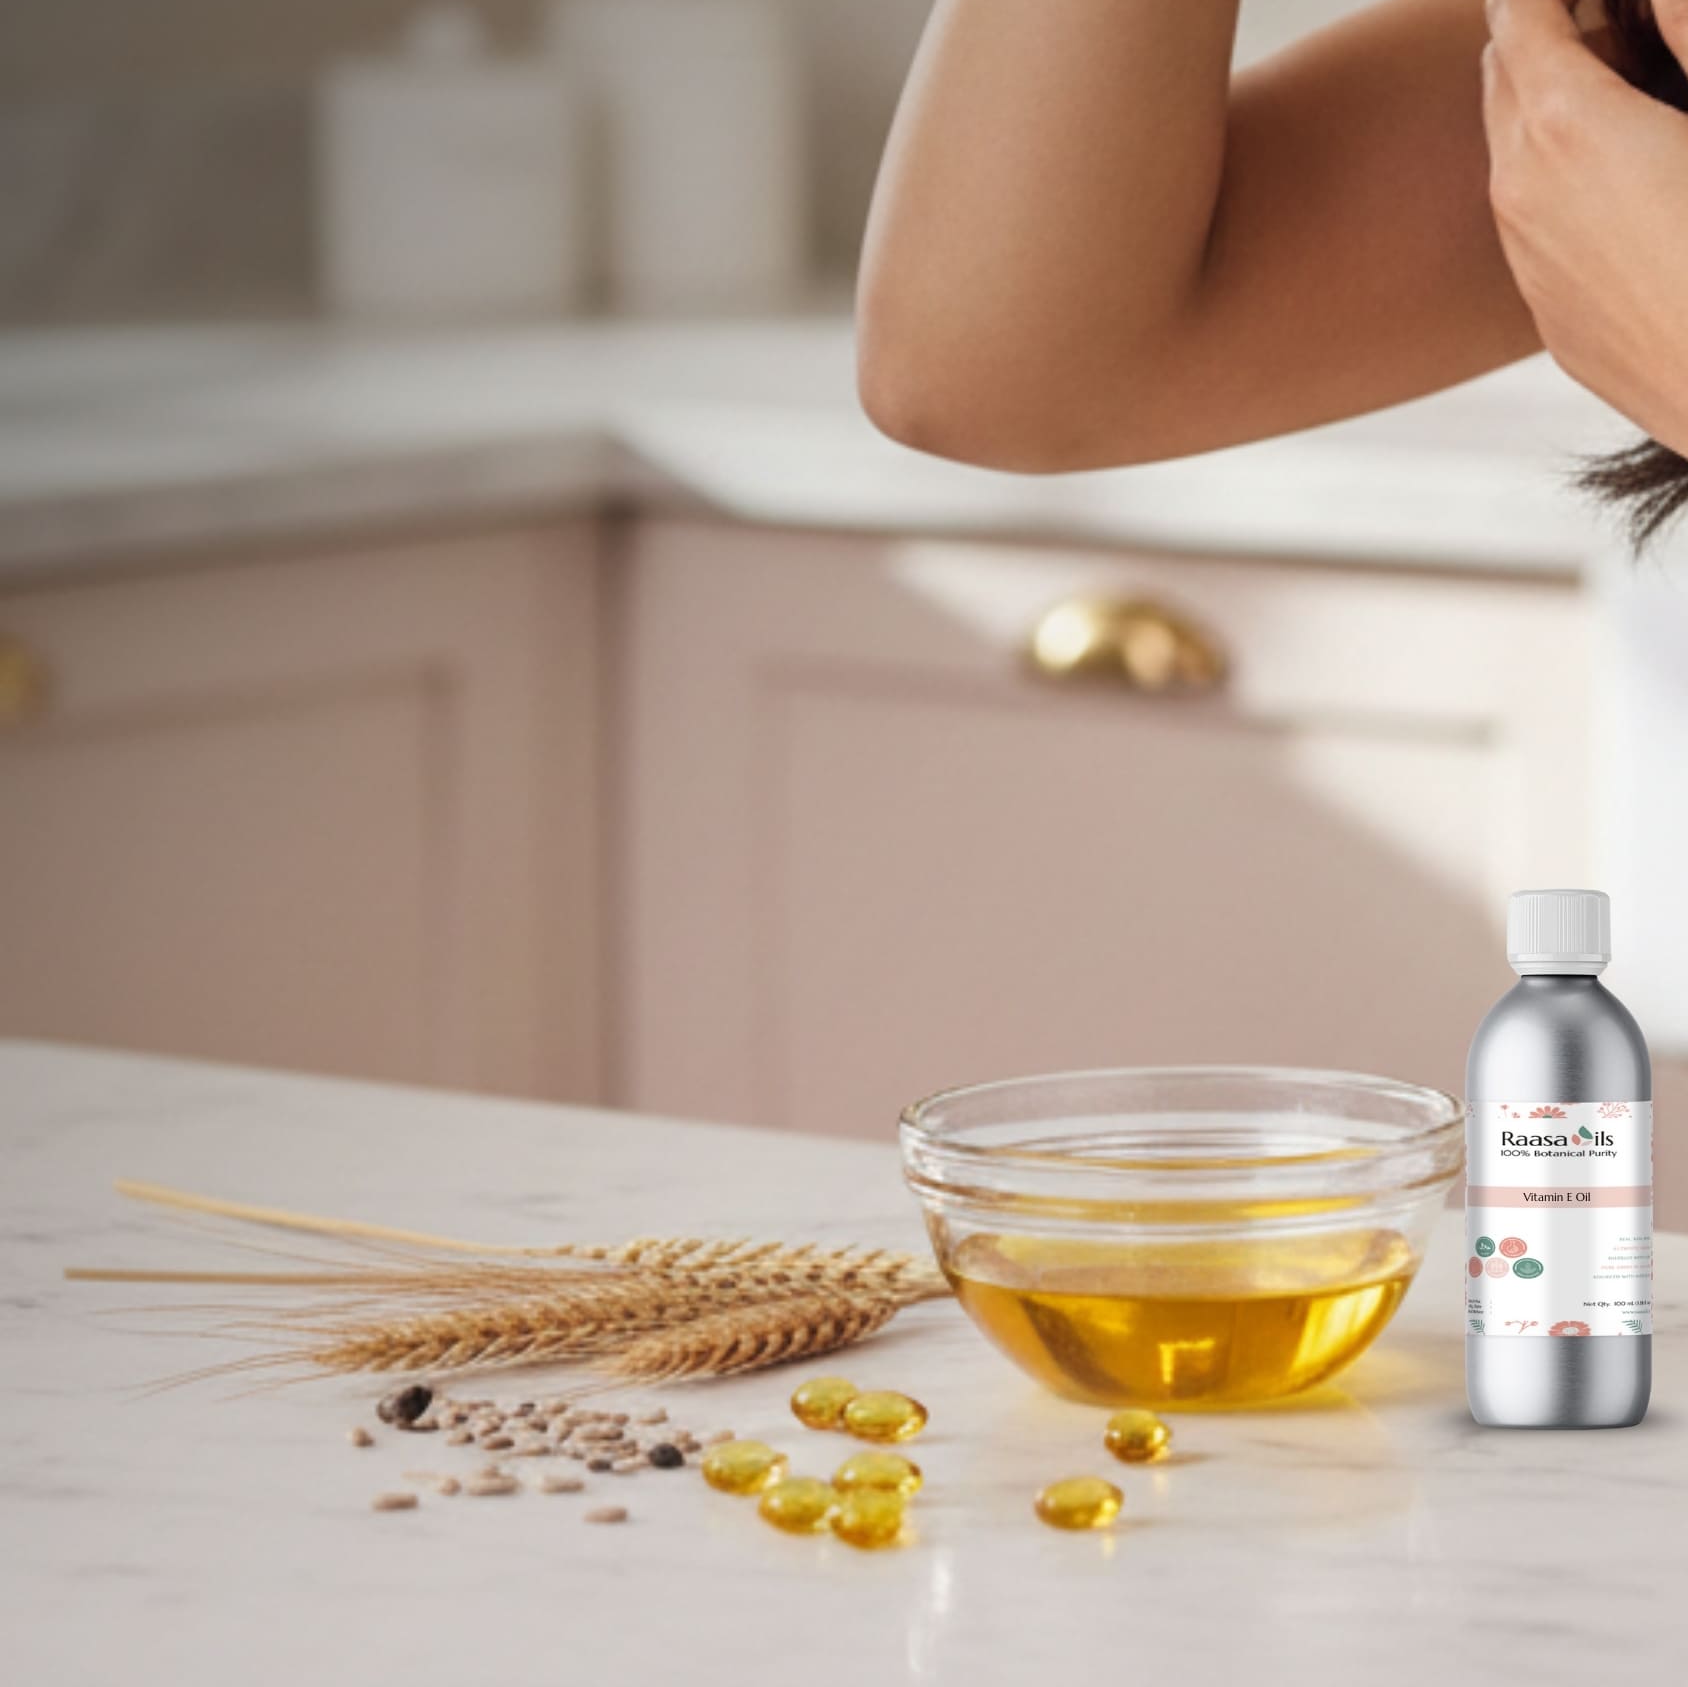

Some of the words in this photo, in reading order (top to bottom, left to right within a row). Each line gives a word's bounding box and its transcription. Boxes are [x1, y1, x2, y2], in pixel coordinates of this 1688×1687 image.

[1501, 1131, 1568, 1147] Raasa
[1500, 1149, 1531, 1157] 100%
[1534, 1149, 1586, 1158] Botanical
[1588, 1149, 1618, 1159] Purity
[1523, 1192, 1564, 1202] Vitamin
[1567, 1192, 1573, 1202] E
[1575, 1192, 1591, 1202] Oil
